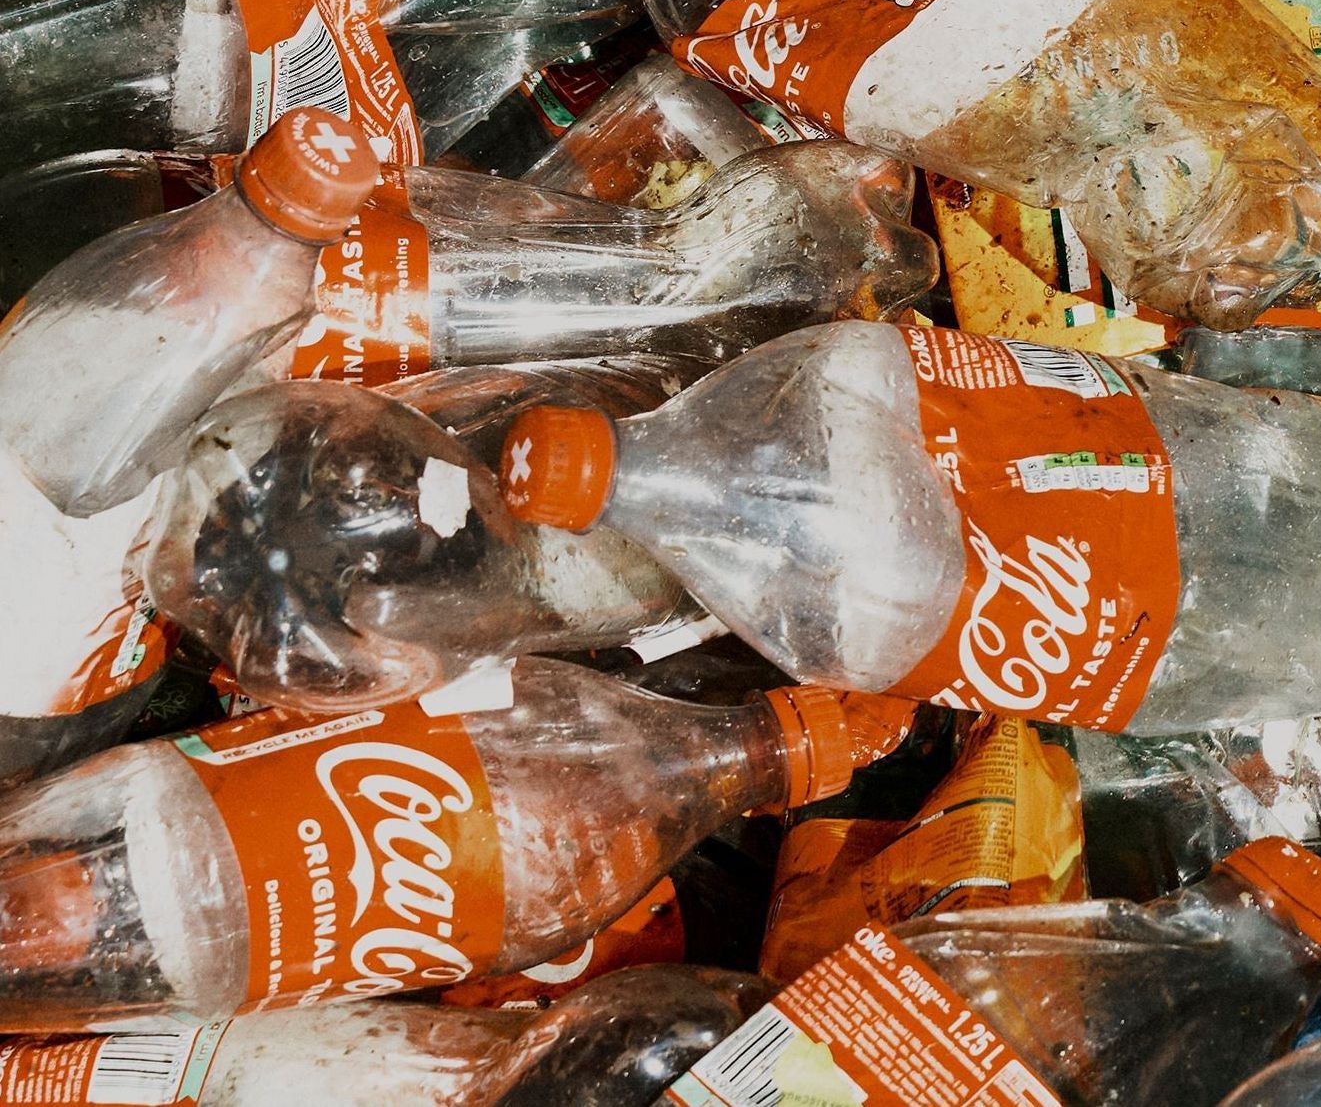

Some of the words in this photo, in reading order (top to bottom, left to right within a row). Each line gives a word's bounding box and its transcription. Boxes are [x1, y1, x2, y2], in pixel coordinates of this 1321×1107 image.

[364, 60, 401, 99] 1.25
[380, 92, 405, 114] L
[299, 141, 340, 176] SWISS
[935, 426, 957, 443] L
[1070, 596, 1118, 692] TASTE
[1102, 636, 1151, 713] Refreshing
[263, 878, 284, 951] Delicious
[296, 818, 336, 976] ORIGINAL
[268, 956, 281, 970] &
[852, 919, 903, 970] oke
[895, 970, 931, 1006] TASTE
[899, 962, 952, 1015] ORIGINAL
[943, 1008, 996, 1060] 1.25
[978, 1043, 1007, 1072] L
